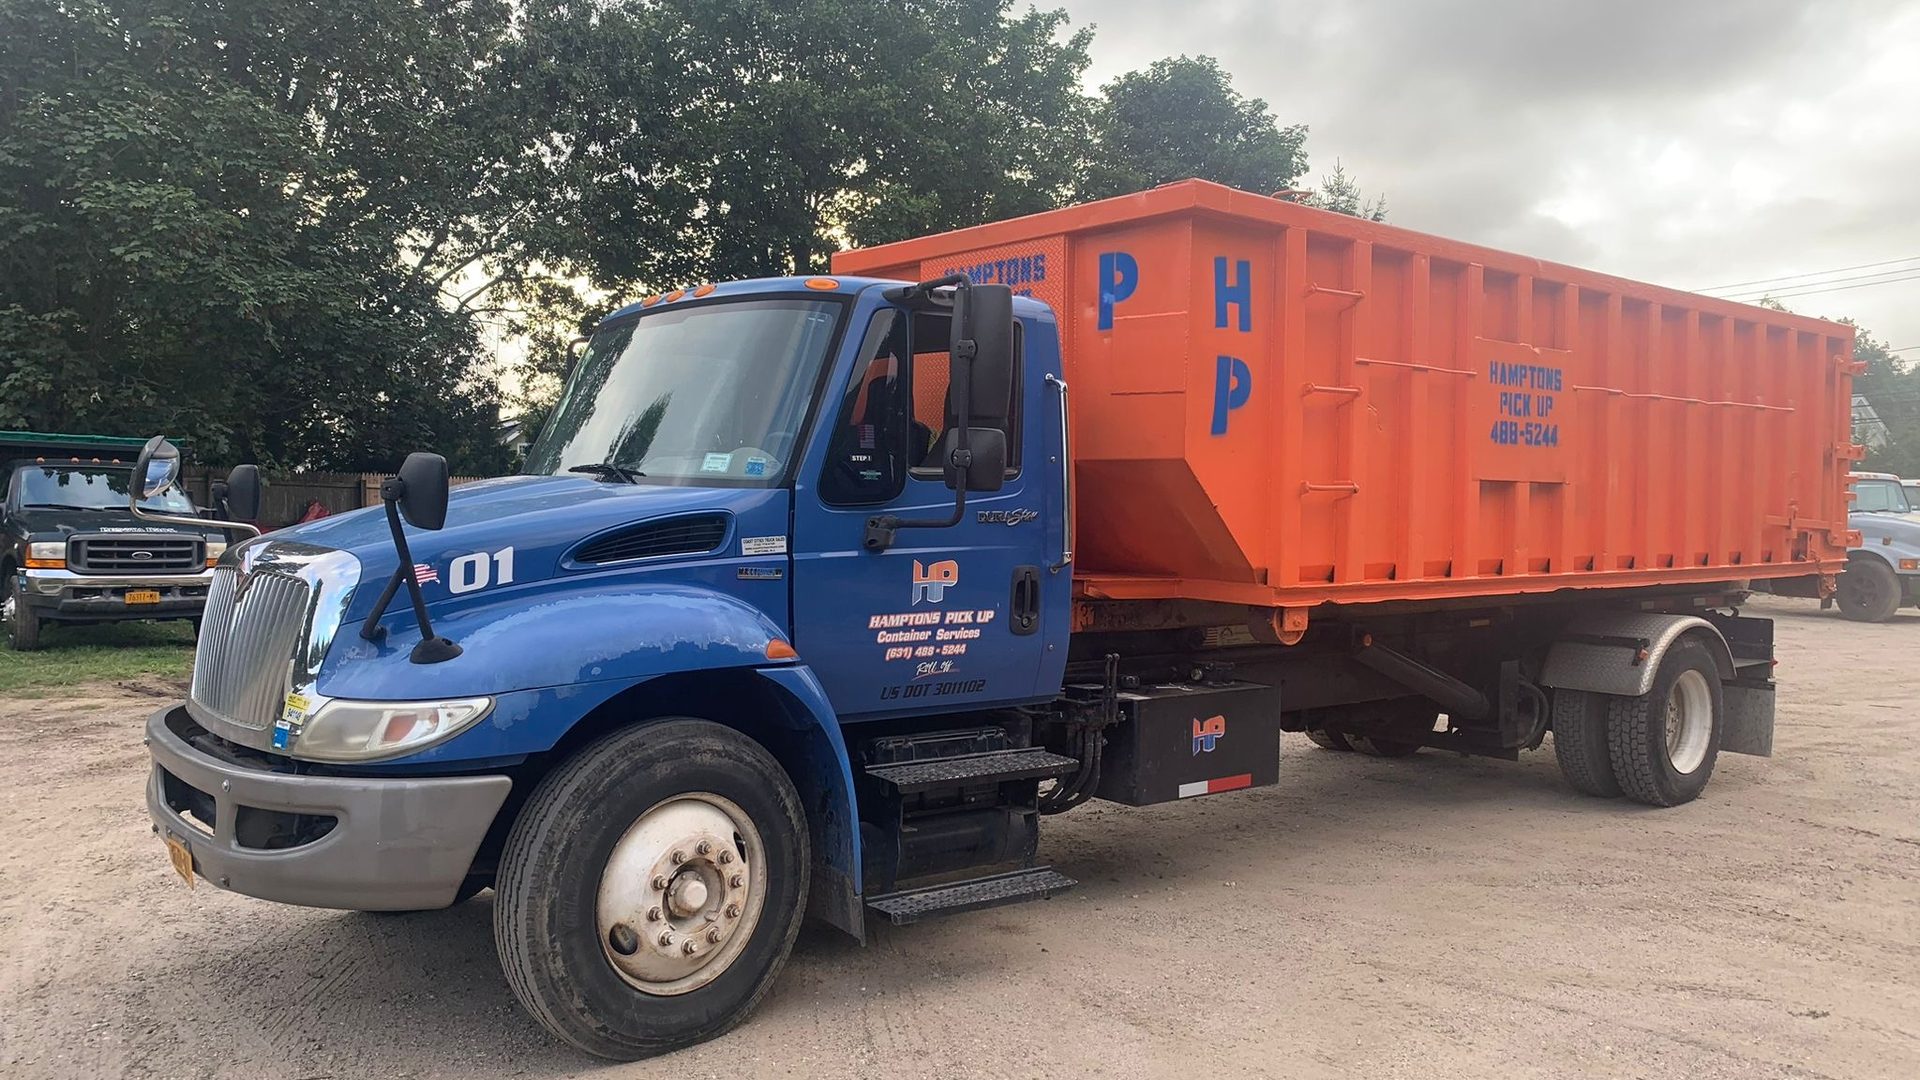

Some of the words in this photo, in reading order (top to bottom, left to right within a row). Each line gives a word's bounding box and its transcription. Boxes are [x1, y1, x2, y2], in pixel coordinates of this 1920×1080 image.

[1489, 360, 1562, 392] HAMPTONS
[1500, 391, 1531, 417] PICK
[1537, 395, 1553, 417] UP
[1491, 420, 1558, 448] 488-5244
[449, 546, 514, 594] 01
[912, 559, 959, 606] HP
[869, 612, 941, 628] HAMPTONS
[944, 611, 975, 625] PICK
[976, 611, 994, 623] UP
[877, 630, 931, 643] Container
[936, 627, 980, 640] Services
[886, 647, 913, 660] (631)
[881, 687, 899, 699] US
[903, 684, 931, 698] DOT
[933, 679, 986, 696] 3011102
[1192, 715, 1226, 757] HP
